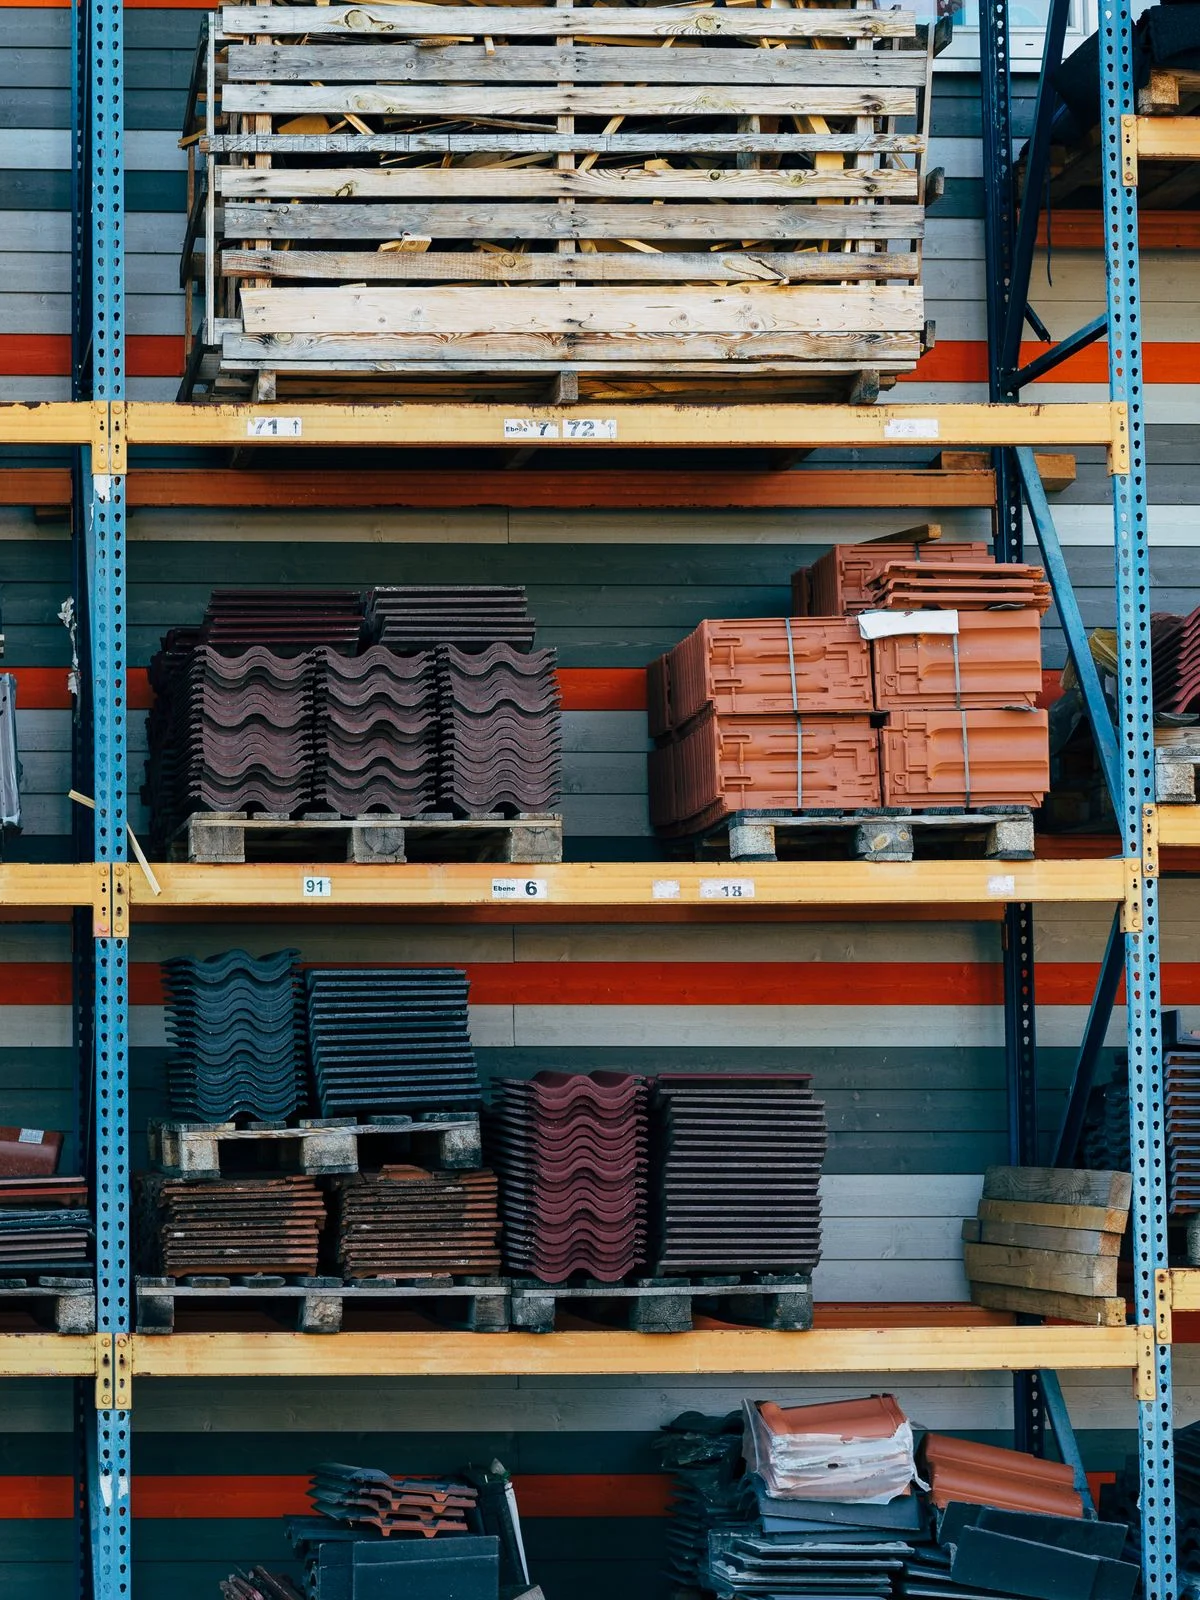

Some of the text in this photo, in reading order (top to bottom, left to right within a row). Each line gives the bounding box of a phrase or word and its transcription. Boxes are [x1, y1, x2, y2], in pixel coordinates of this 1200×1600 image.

[256, 419, 278, 434] 71
[539, 422, 549, 436] 7
[567, 420, 595, 436] 72
[306, 879, 323, 893] 91
[525, 880, 538, 896] 6
